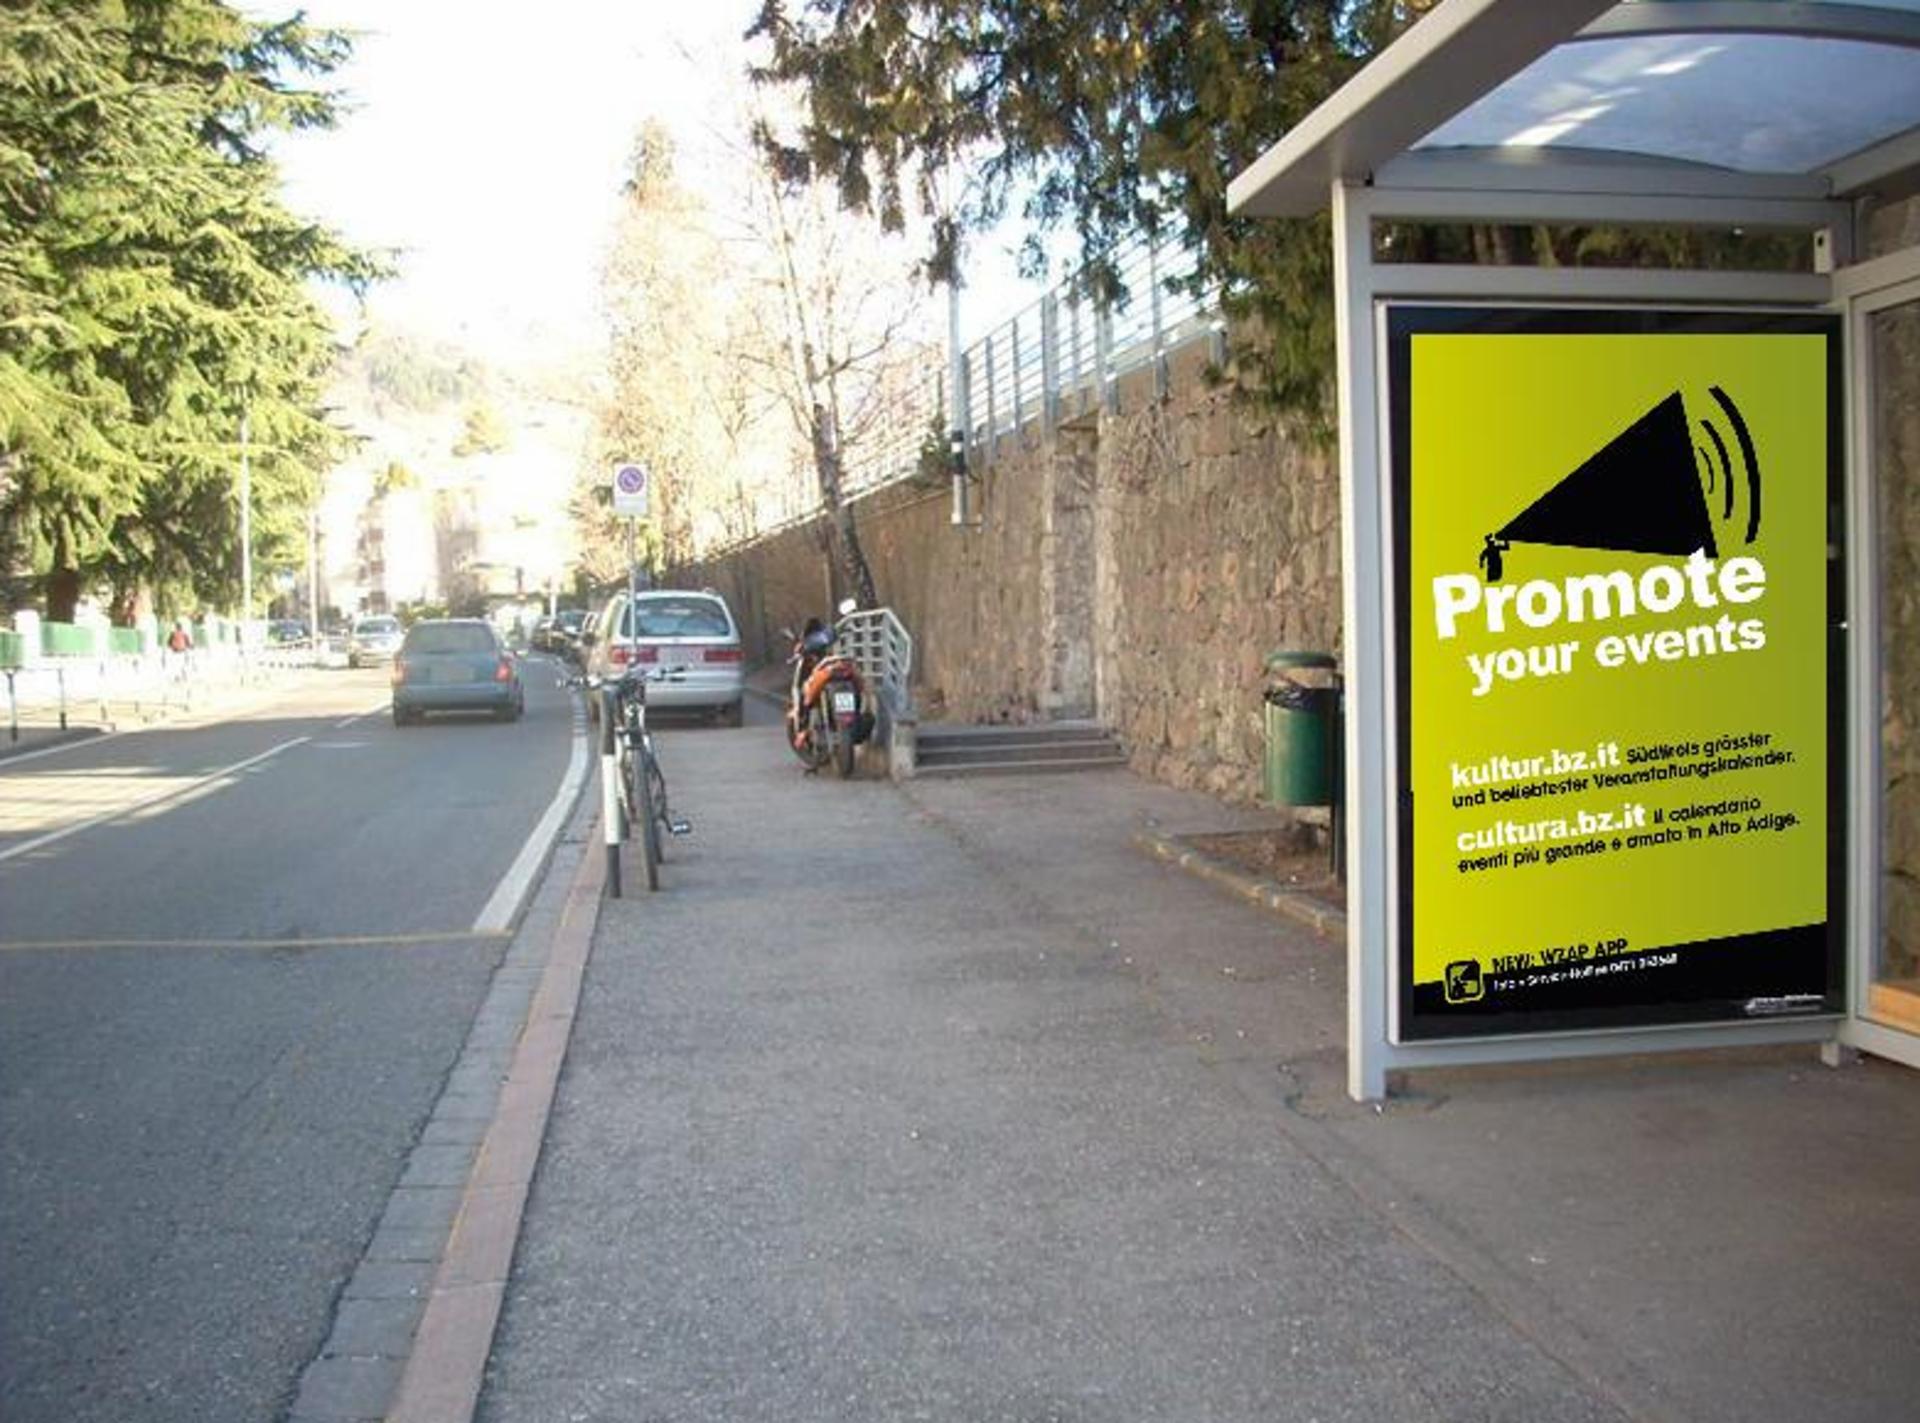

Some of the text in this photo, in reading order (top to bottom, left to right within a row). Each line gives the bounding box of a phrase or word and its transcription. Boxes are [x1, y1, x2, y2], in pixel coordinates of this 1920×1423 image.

[1433, 548, 1766, 640] Promote
[1467, 614, 1767, 696] your events
[1452, 733, 1772, 789] kultur.bz.it Südtirols grösster
[1452, 750, 1796, 808] und beliebtester Veranstaltungskalender.
[1457, 803, 1645, 851] cultura.bz.it
[1669, 797, 1762, 822] calendario
[1458, 813, 1800, 873] eventi più grande e amato in Alto Adige.
[1595, 938, 1628, 957] APP
